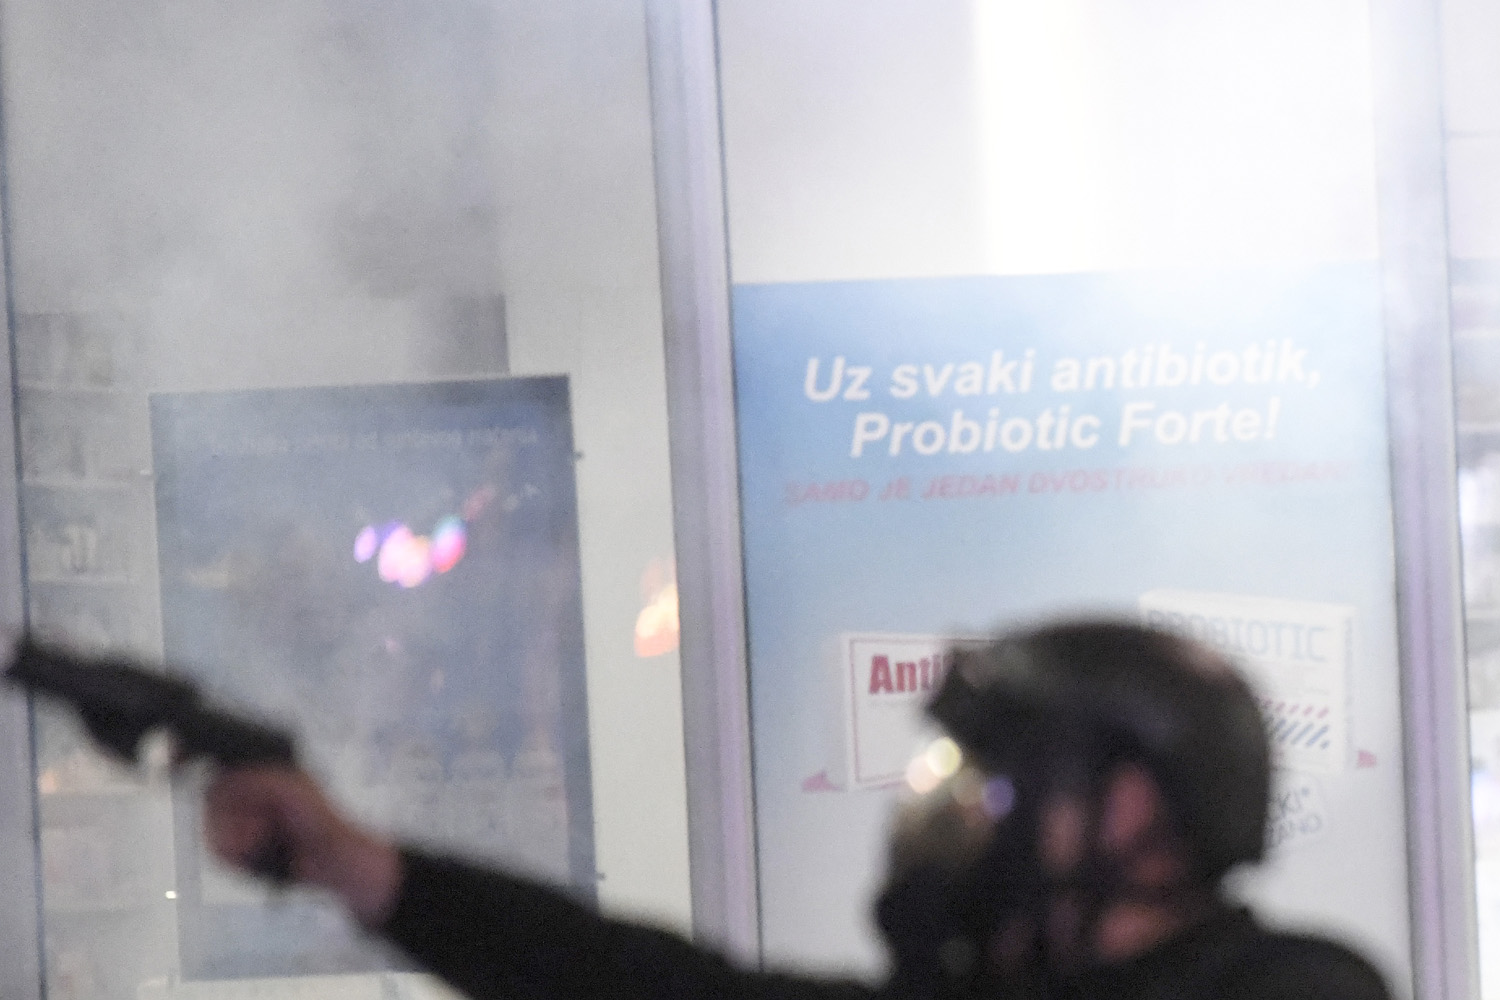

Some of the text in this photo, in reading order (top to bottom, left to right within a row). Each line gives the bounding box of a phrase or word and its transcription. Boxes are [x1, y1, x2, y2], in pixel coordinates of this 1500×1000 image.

[804, 338, 1322, 402] Uz svaki antibiotik,
[850, 397, 1280, 458] Probiotic Forte!
[878, 477, 912, 502] JE
[921, 473, 1021, 500] JEDAN
